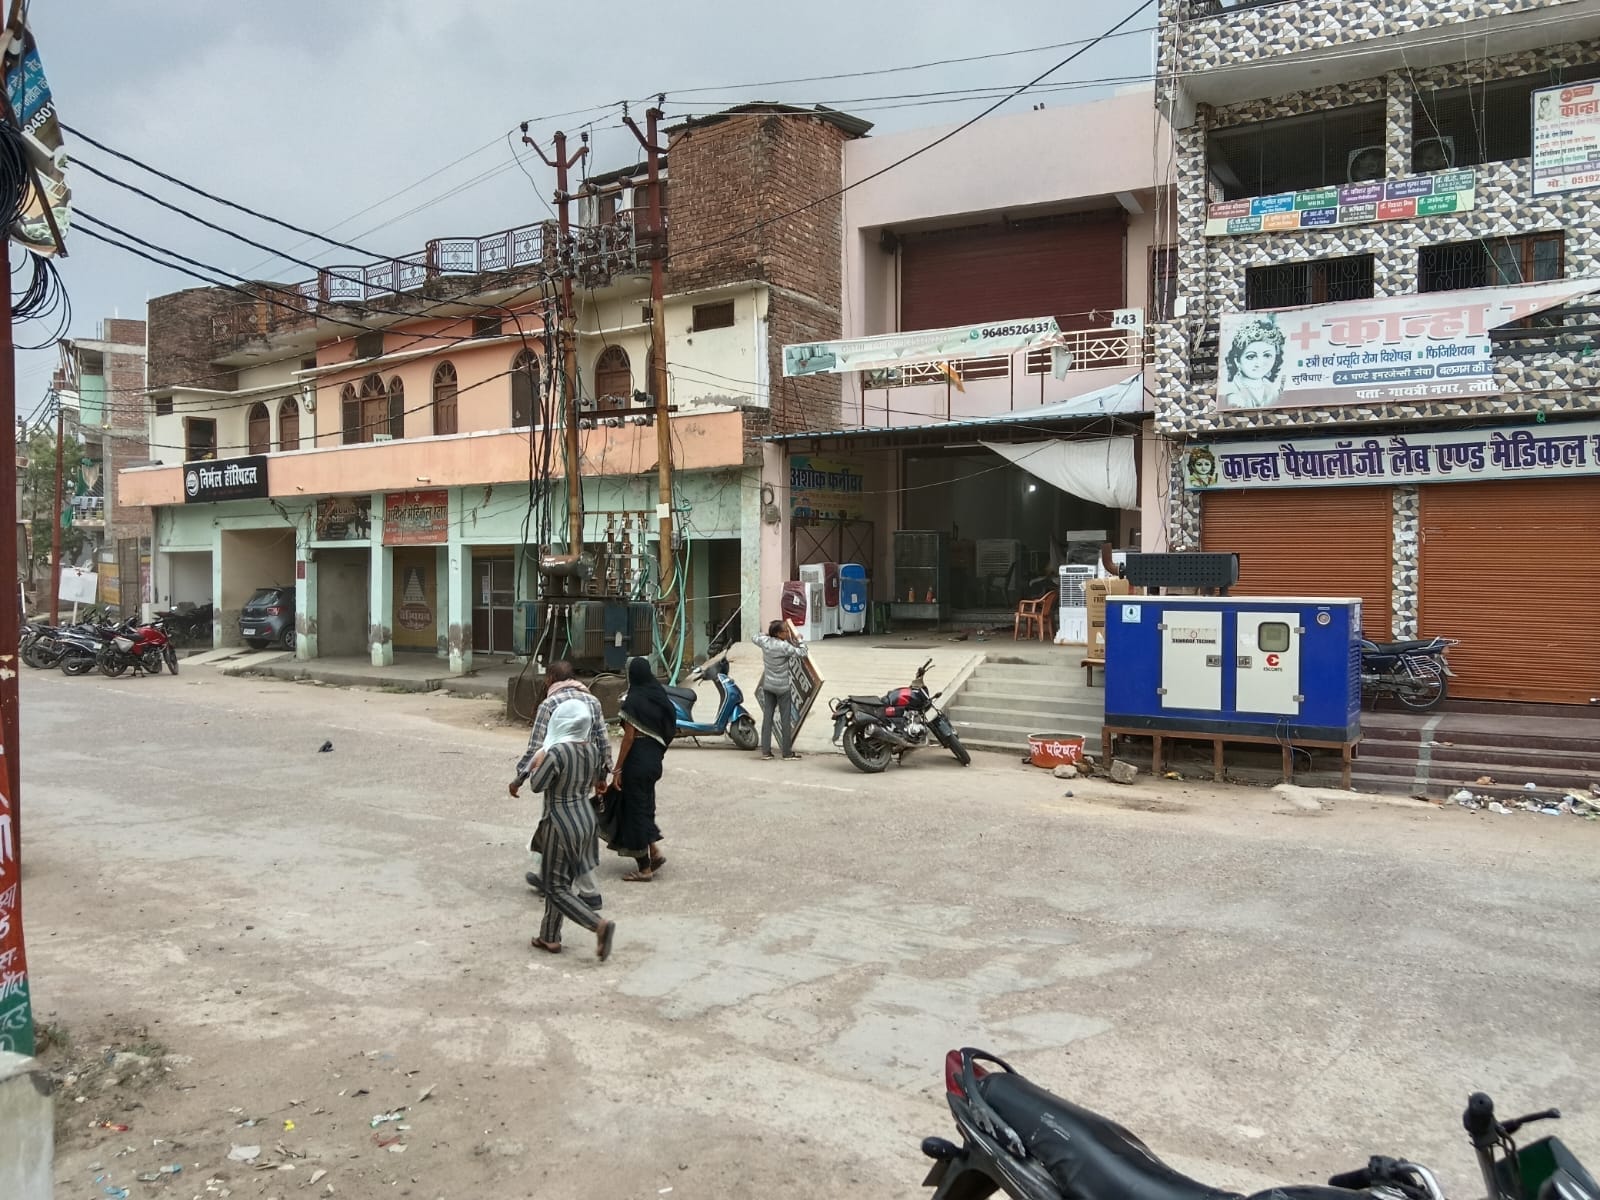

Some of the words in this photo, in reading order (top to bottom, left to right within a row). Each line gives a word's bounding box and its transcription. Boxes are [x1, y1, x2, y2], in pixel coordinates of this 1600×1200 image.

[1560, 99, 1600, 118] कान्हा
[1322, 303, 1489, 348] कान्हा
[1305, 354, 1320, 368] स्त्री
[1322, 353, 1336, 367] एवं
[1336, 352, 1360, 369] प्रसूति
[1362, 350, 1378, 364] रोग
[1426, 344, 1476, 359] फिजिशियन
[1336, 374, 1348, 382] 24
[1472, 361, 1485, 373] की
[1220, 452, 1280, 482] कान्हा
[1388, 435, 1431, 475] लैब
[1432, 441, 1486, 474] एण्ड
[1488, 430, 1587, 471] मेडिकल
[199, 466, 222, 489] निर्मल
[790, 463, 826, 489] अशोक
